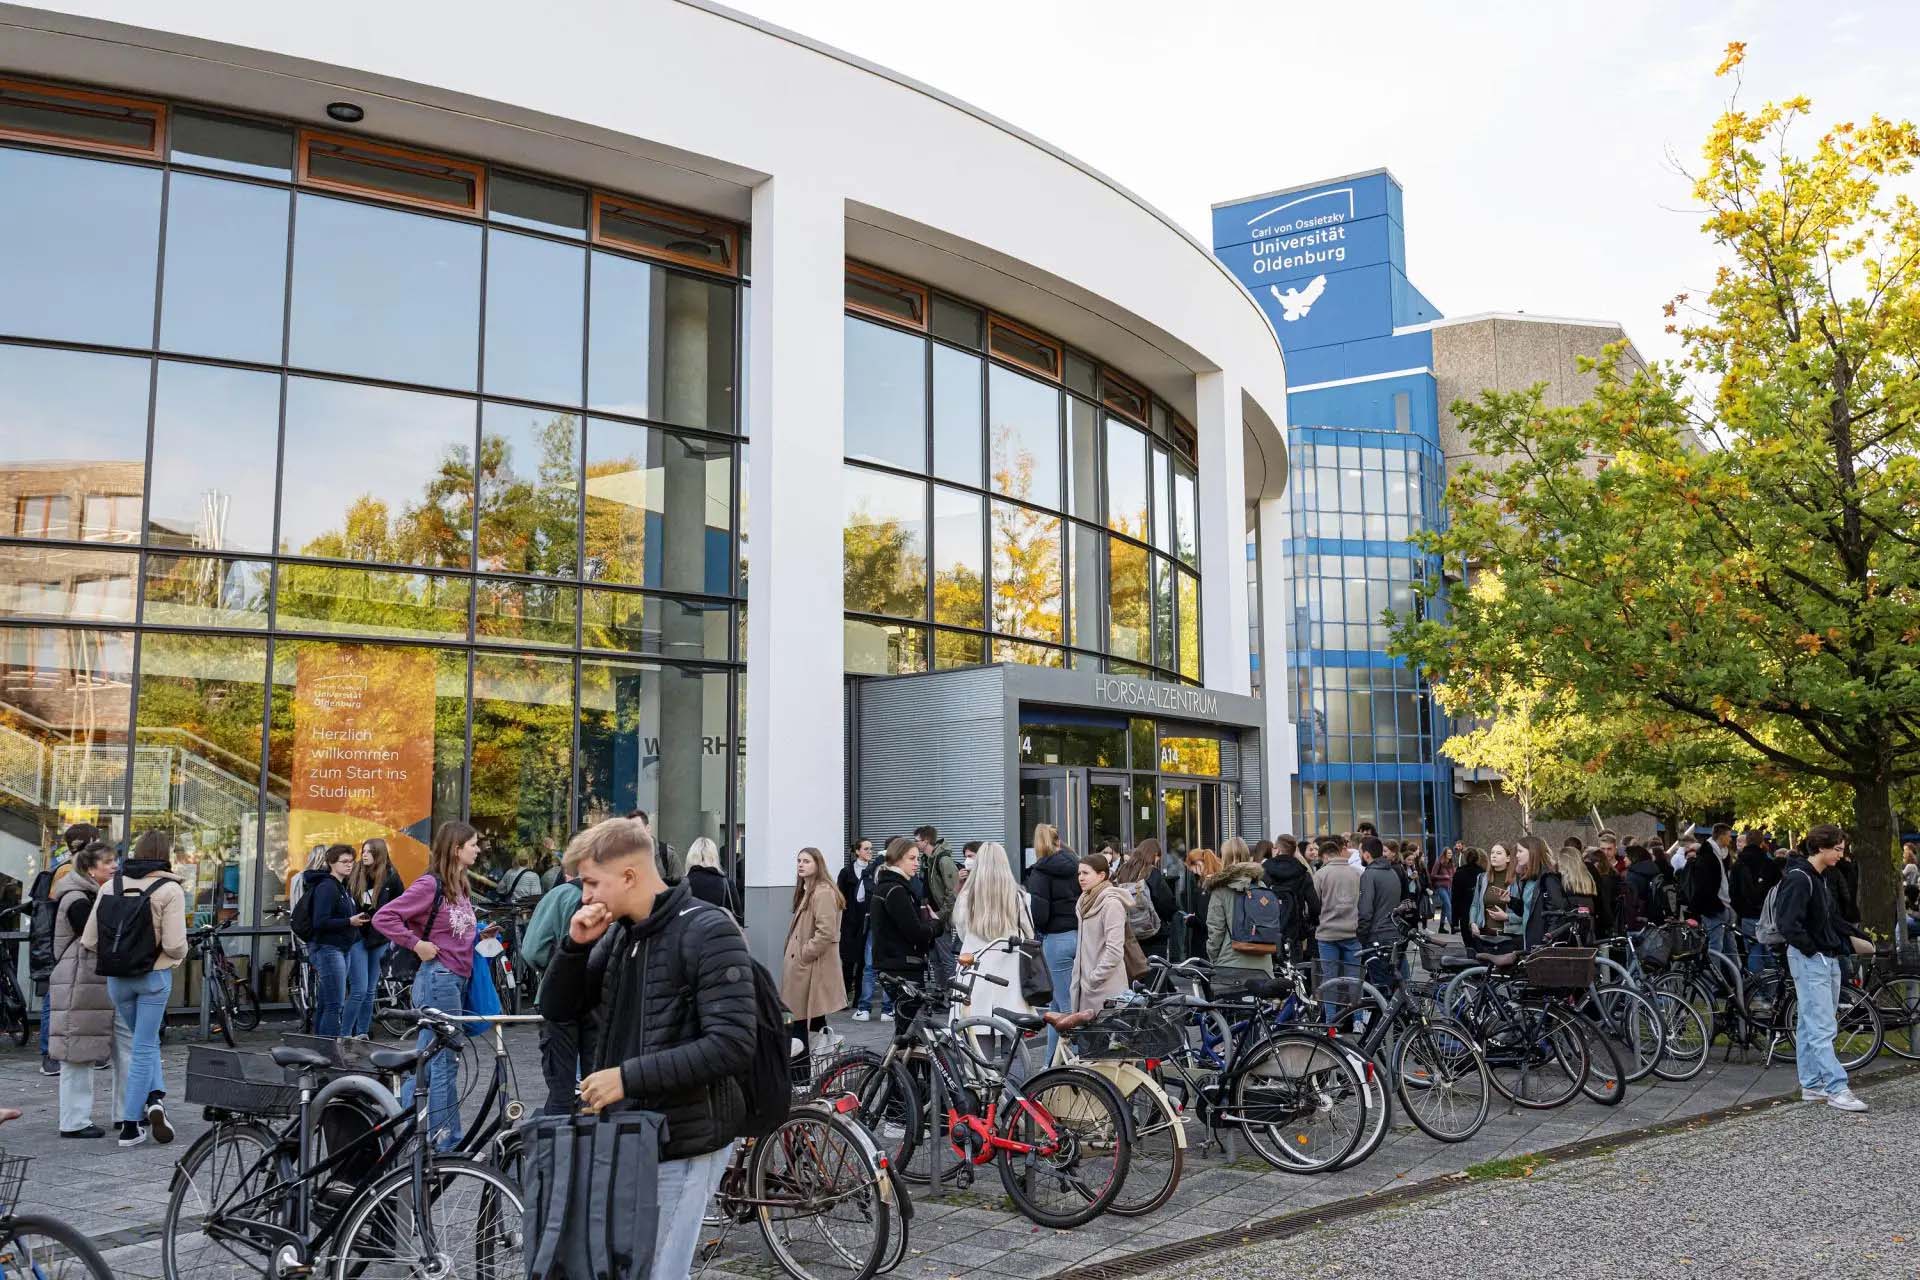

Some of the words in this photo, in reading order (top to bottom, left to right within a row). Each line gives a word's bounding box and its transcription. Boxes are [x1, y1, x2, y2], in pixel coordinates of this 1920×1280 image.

[1251, 226, 1271, 239] Carl
[1274, 224, 1293, 234] von
[1295, 212, 1345, 230] Ossietzky
[1252, 226, 1346, 256] Universität
[1253, 247, 1346, 274] Oldenburg
[312, 727, 372, 741] Herzlich
[311, 747, 399, 761] willkommen
[1161, 746, 1179, 765] A14
[309, 768, 342, 779] zum
[346, 765, 382, 779] Start
[387, 768, 407, 780] ins
[309, 784, 375, 798] Studium!
